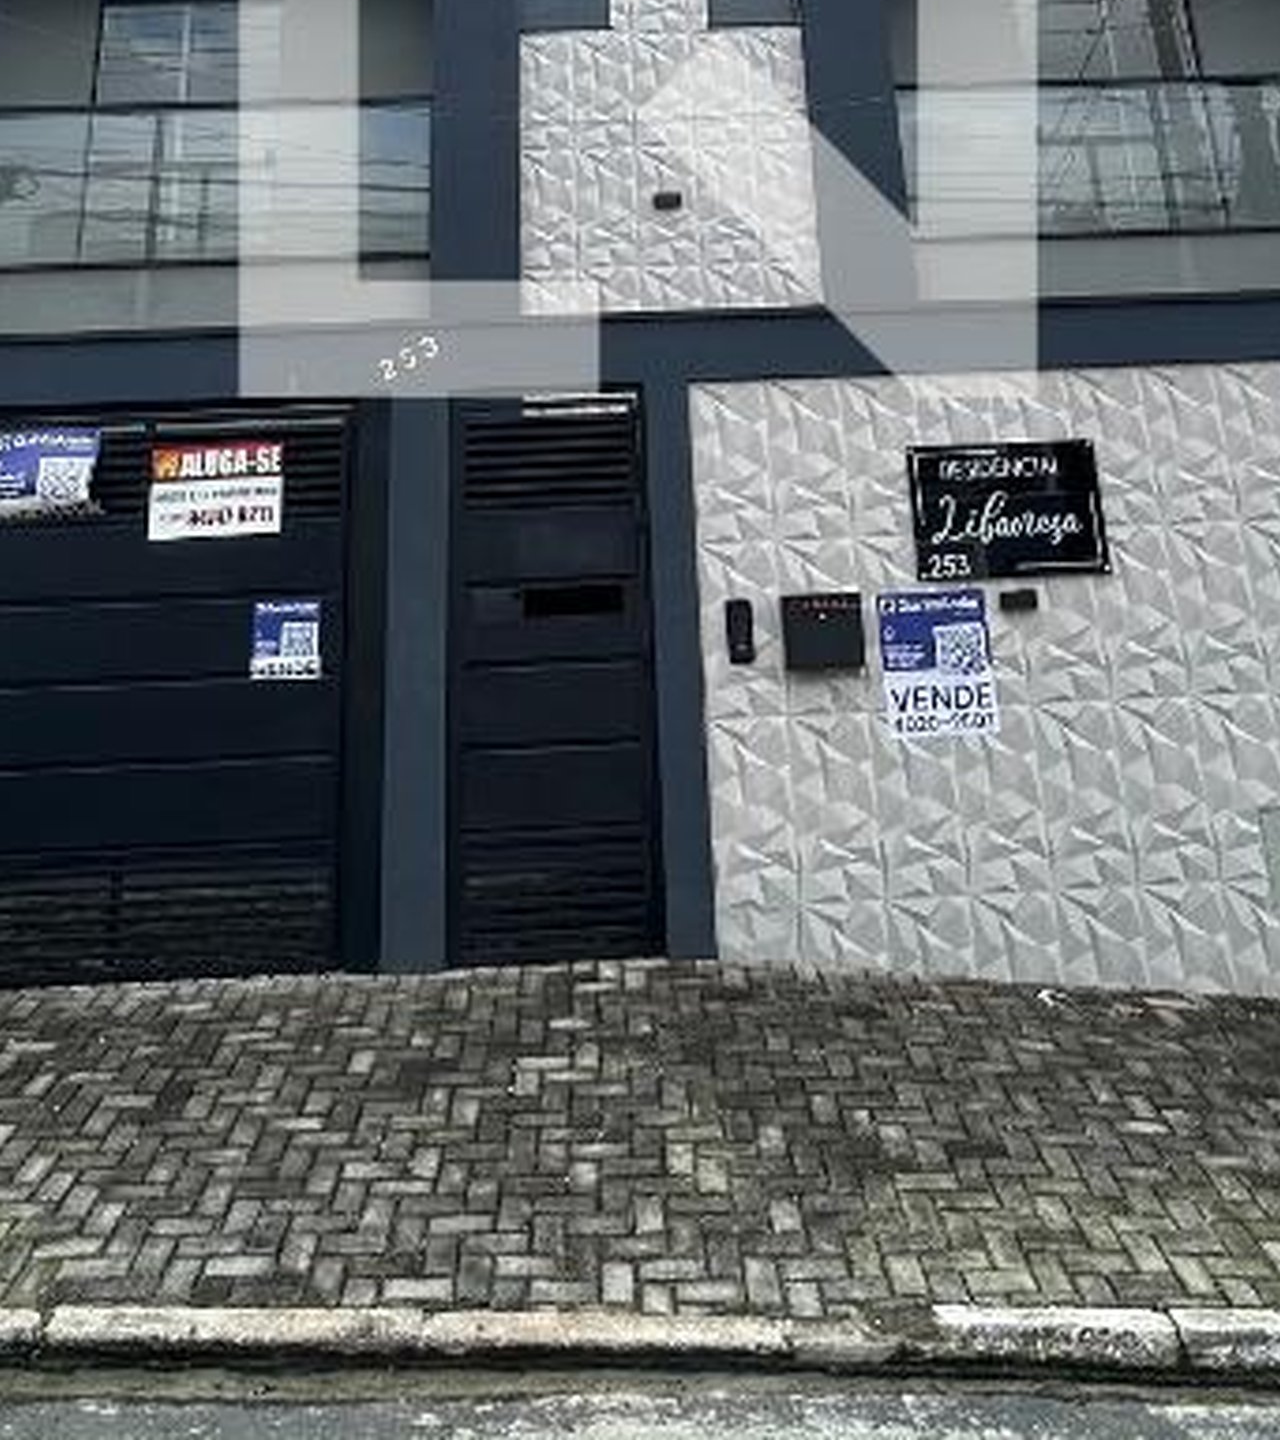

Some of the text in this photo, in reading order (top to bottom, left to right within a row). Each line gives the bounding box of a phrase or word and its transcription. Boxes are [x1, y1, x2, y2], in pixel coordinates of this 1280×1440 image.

[377, 335, 439, 380] 253
[180, 445, 283, 478] ALUGA-SE
[928, 553, 971, 579] 253
[890, 682, 993, 712] VENDE
